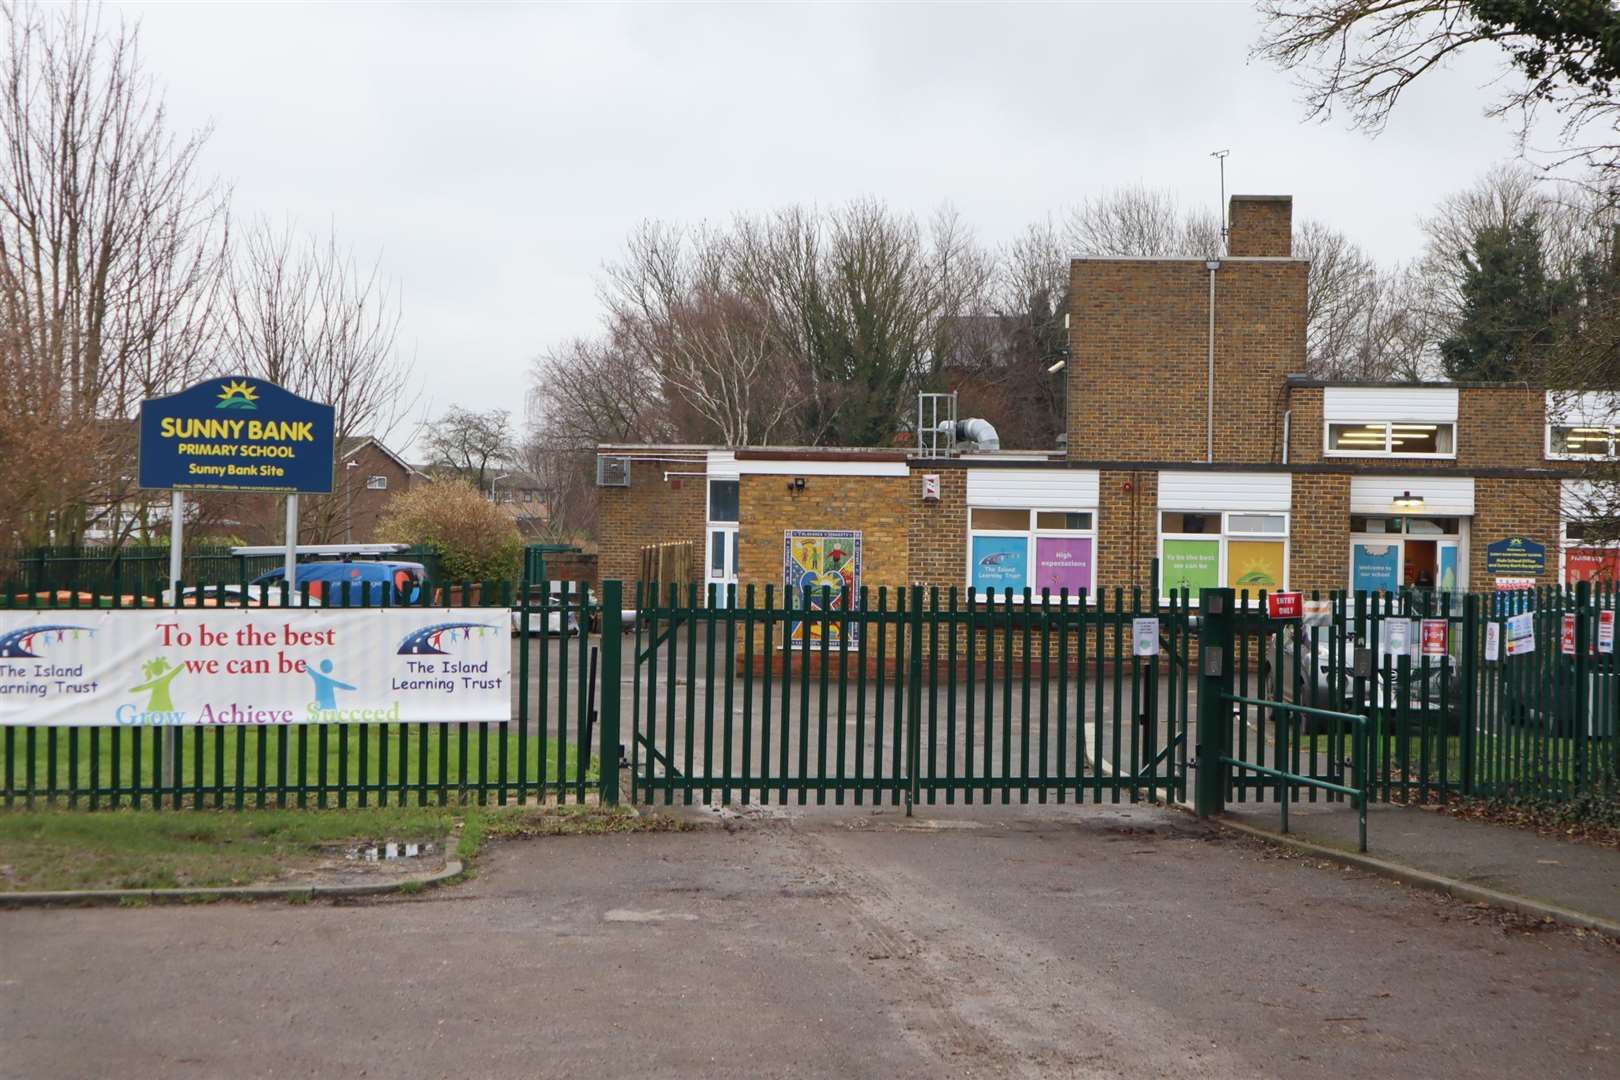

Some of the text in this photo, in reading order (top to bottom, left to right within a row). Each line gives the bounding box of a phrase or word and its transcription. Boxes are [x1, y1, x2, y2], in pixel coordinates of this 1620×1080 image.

[160, 417, 314, 441] SUNNY BANK
[178, 443, 295, 458] PRIMARY SCHOOL
[188, 463, 285, 477] Sunny Bank Site
[1055, 551, 1072, 559] High
[155, 623, 336, 647] To be the best
[184, 651, 307, 674] we can be
[407, 660, 488, 673] The Island
[0, 664, 83, 677] The Island
[0, 681, 98, 698] arning Trust
[392, 677, 502, 692] Learning Trust
[115, 701, 400, 726] Grow Achieve Succeed
